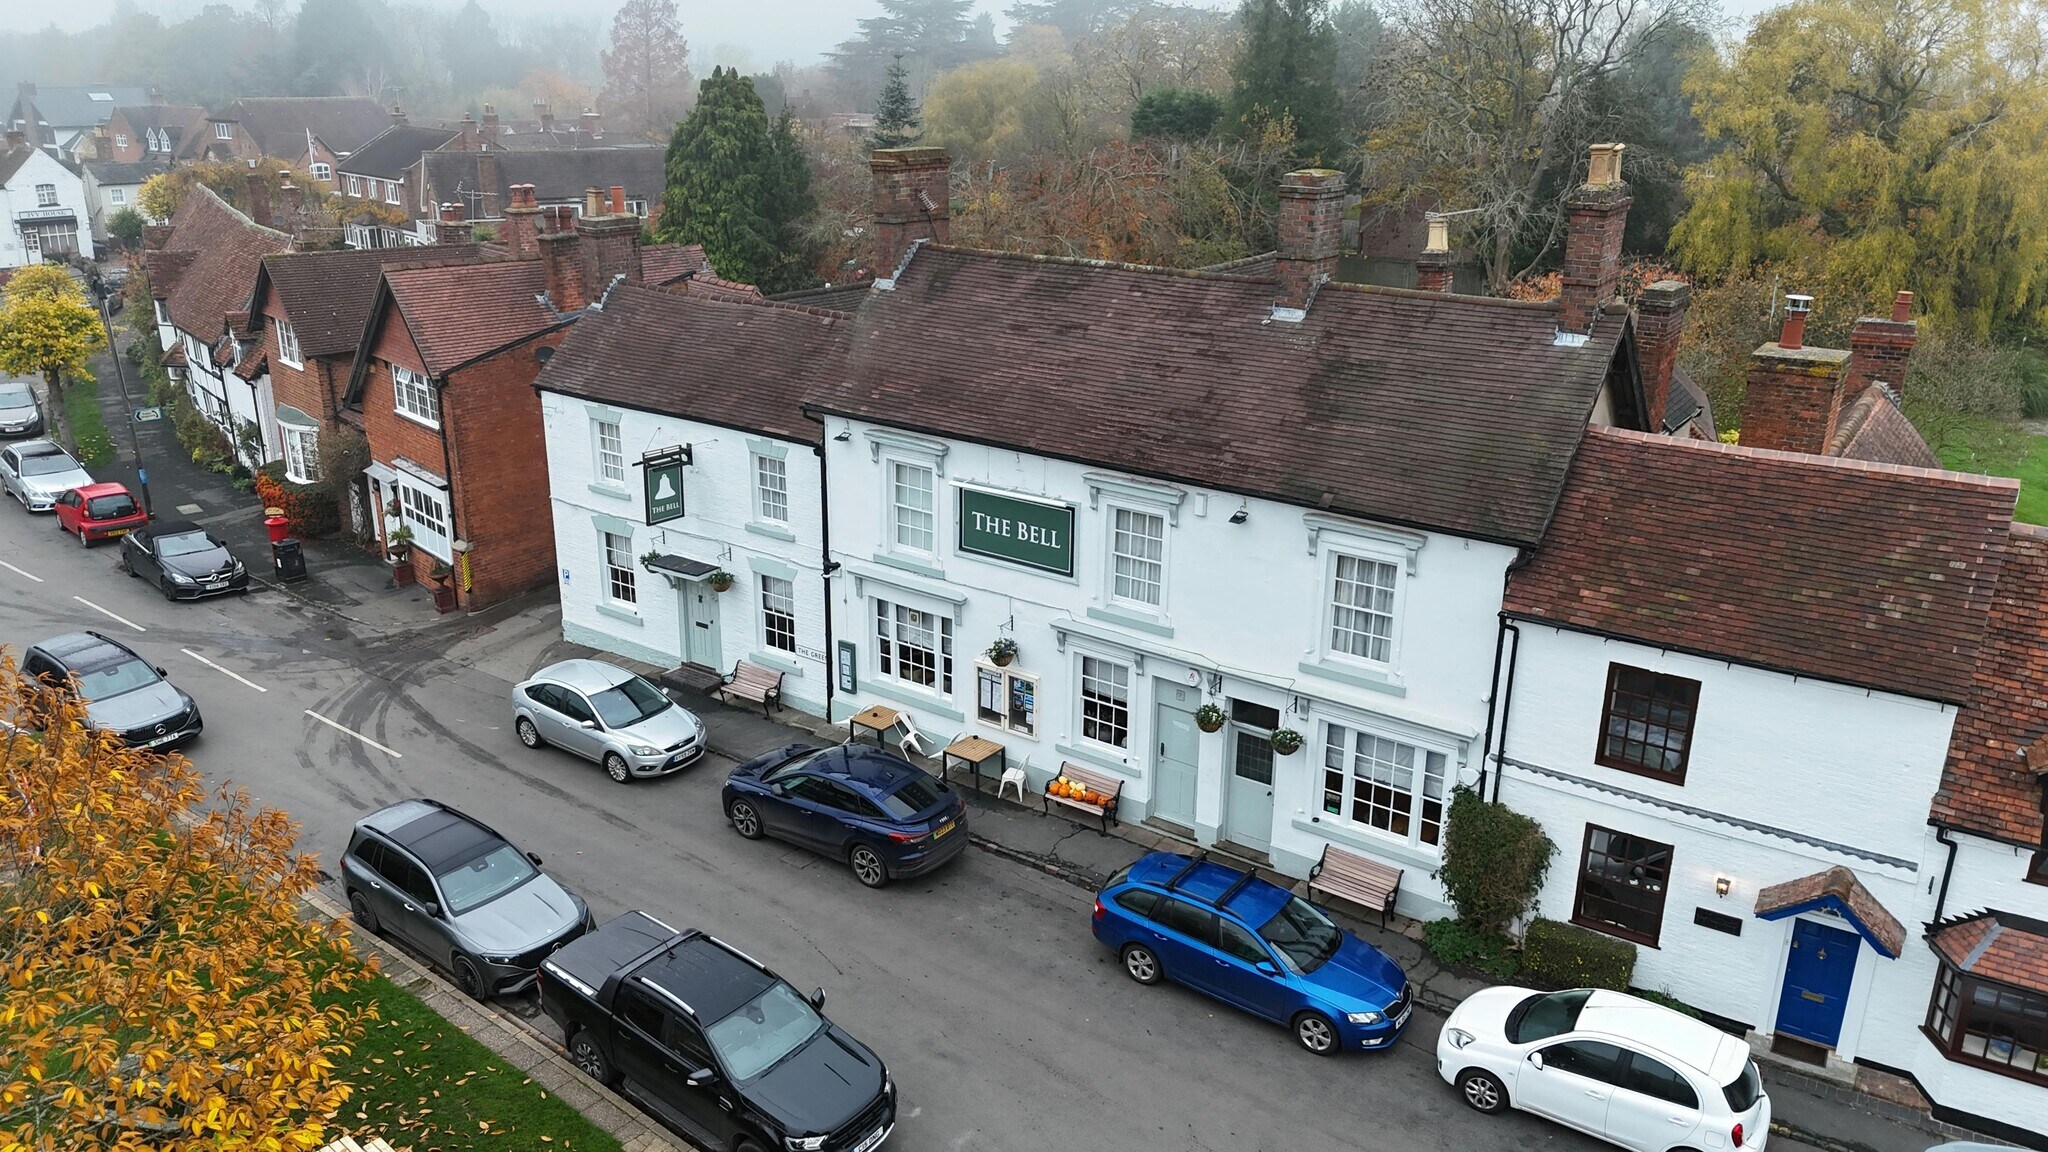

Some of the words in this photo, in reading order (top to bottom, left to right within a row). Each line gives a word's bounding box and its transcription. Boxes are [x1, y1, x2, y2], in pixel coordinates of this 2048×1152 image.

[652, 505, 665, 514] THE
[666, 502, 680, 511] BELL
[971, 510, 1011, 537] THE
[1017, 521, 1061, 549] BELL
[798, 647, 809, 656] THE
[811, 651, 826, 661] GREE
